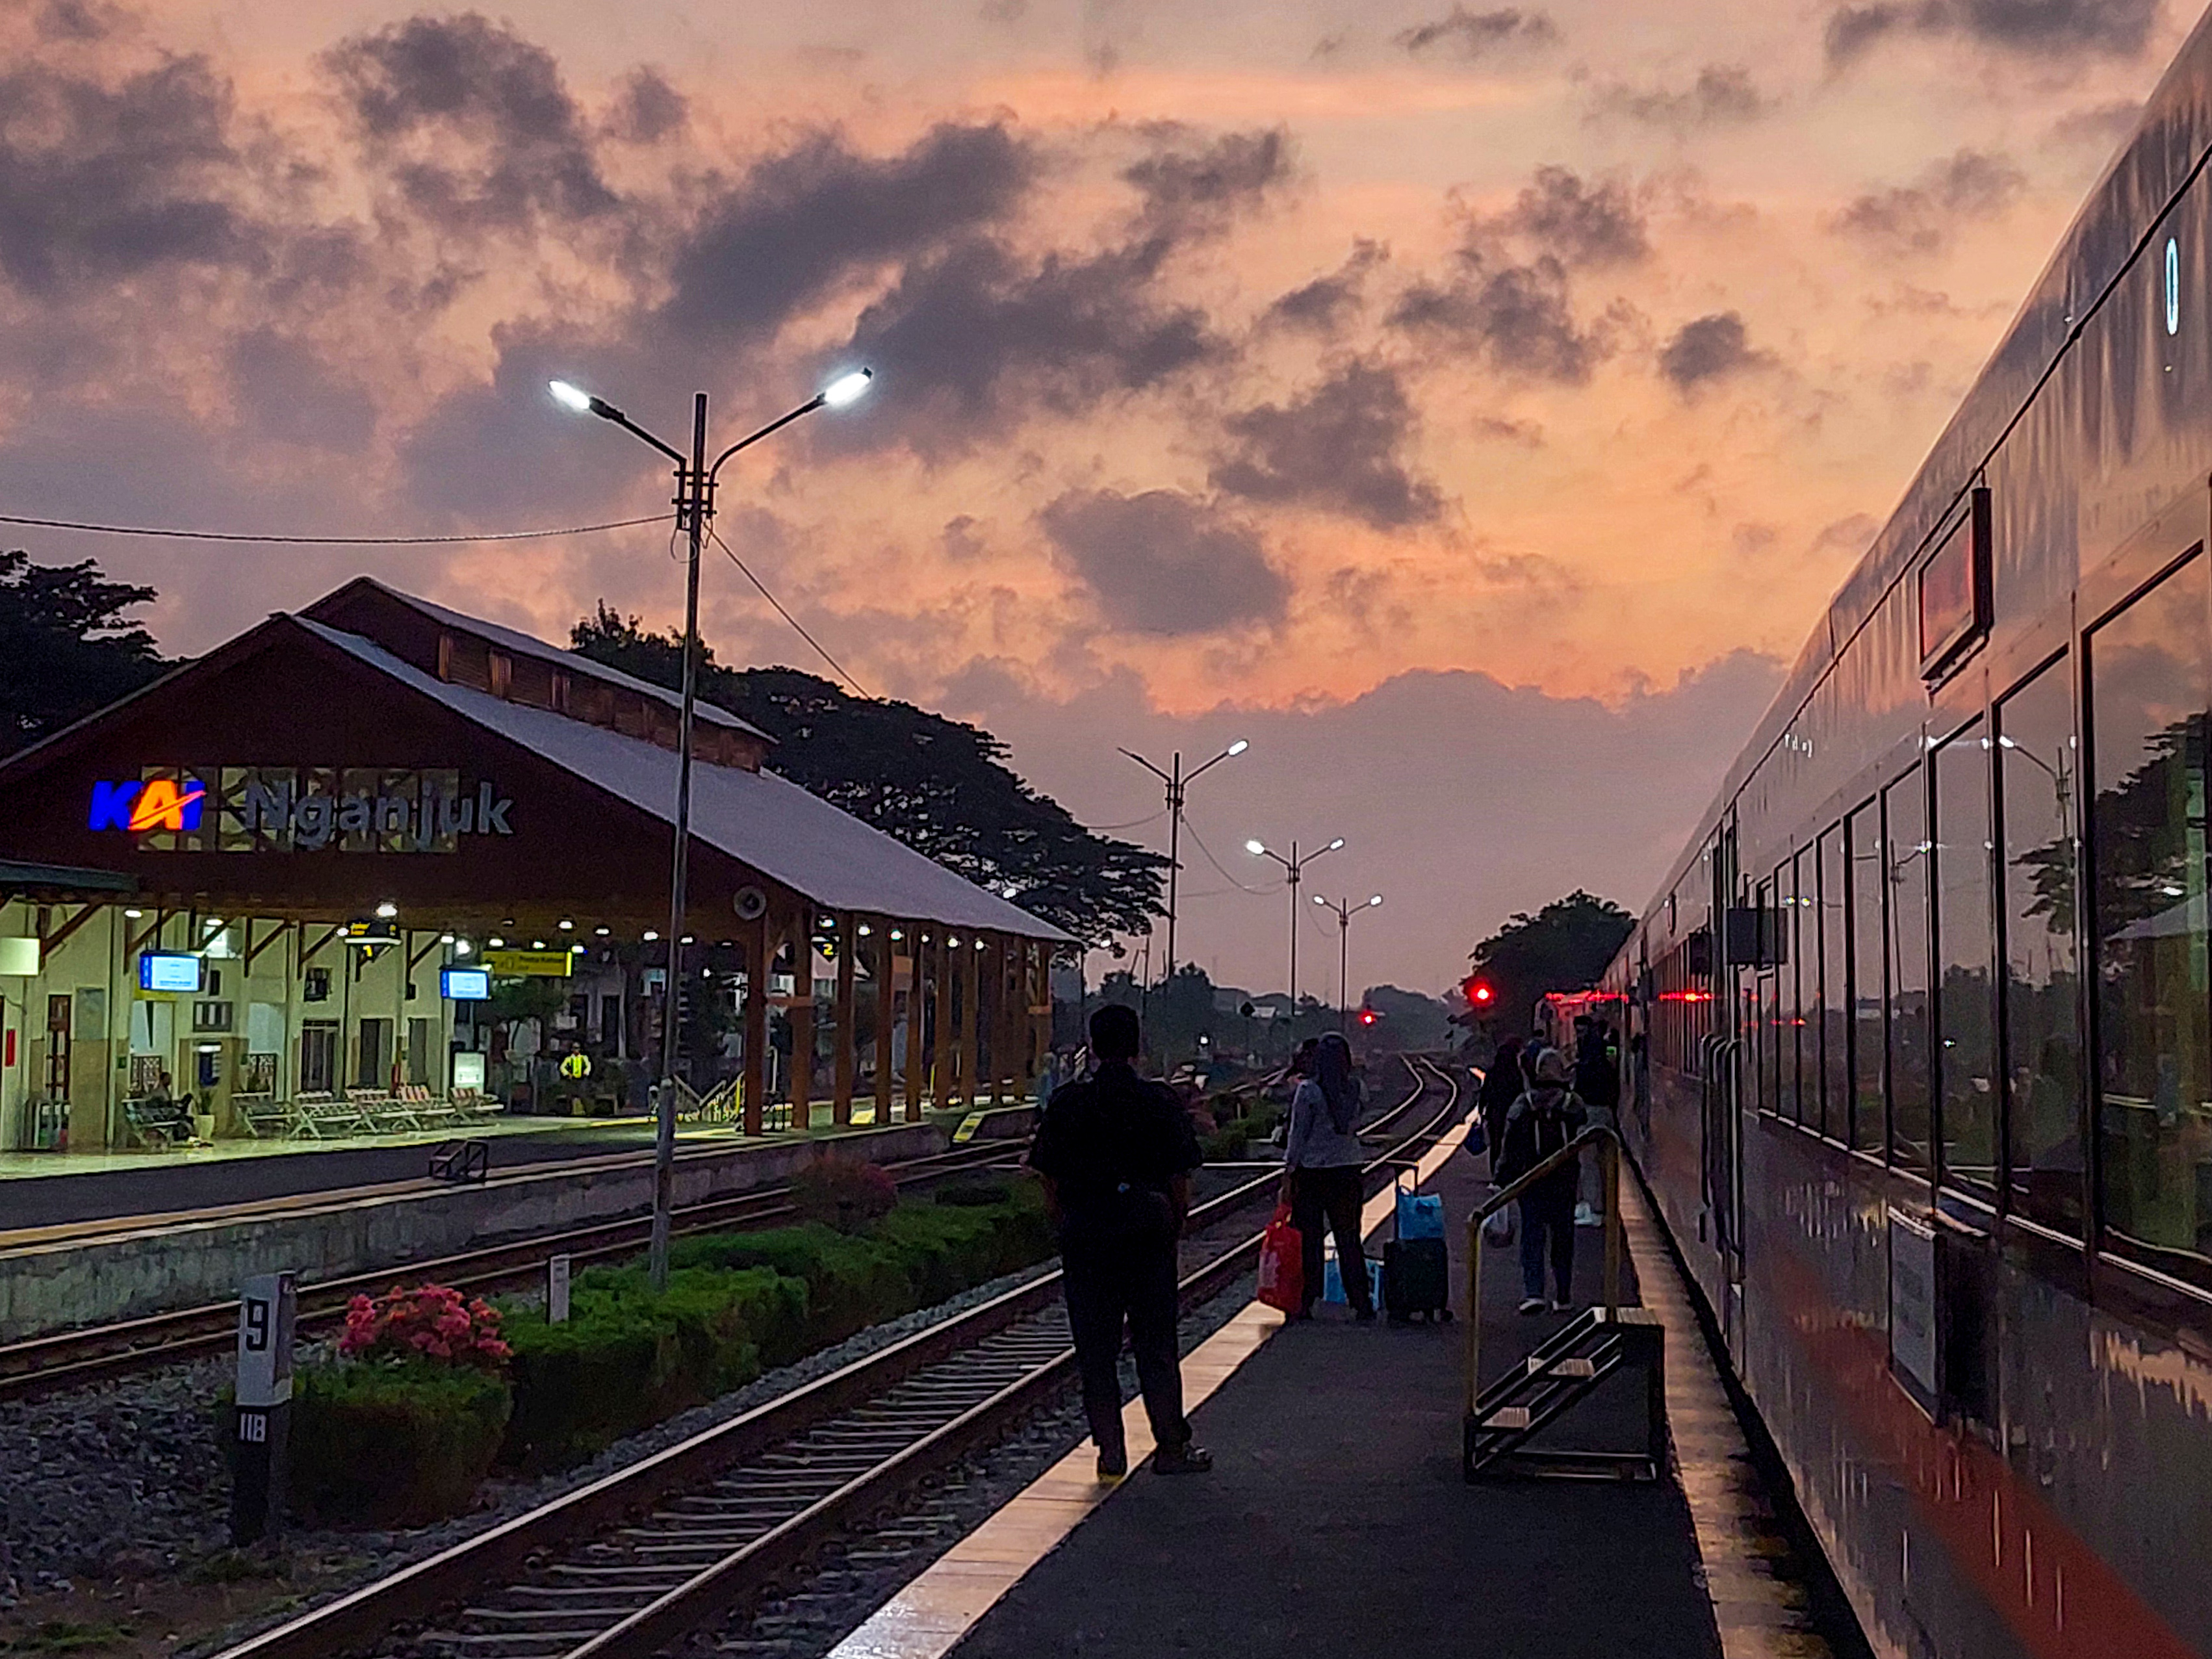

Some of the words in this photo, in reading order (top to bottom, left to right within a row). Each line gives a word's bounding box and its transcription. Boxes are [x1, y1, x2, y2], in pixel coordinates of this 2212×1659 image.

[88, 780, 207, 830] KAI
[244, 780, 514, 852] Nganjuk
[823, 943, 834, 955] 2
[246, 1298, 269, 1351] 9
